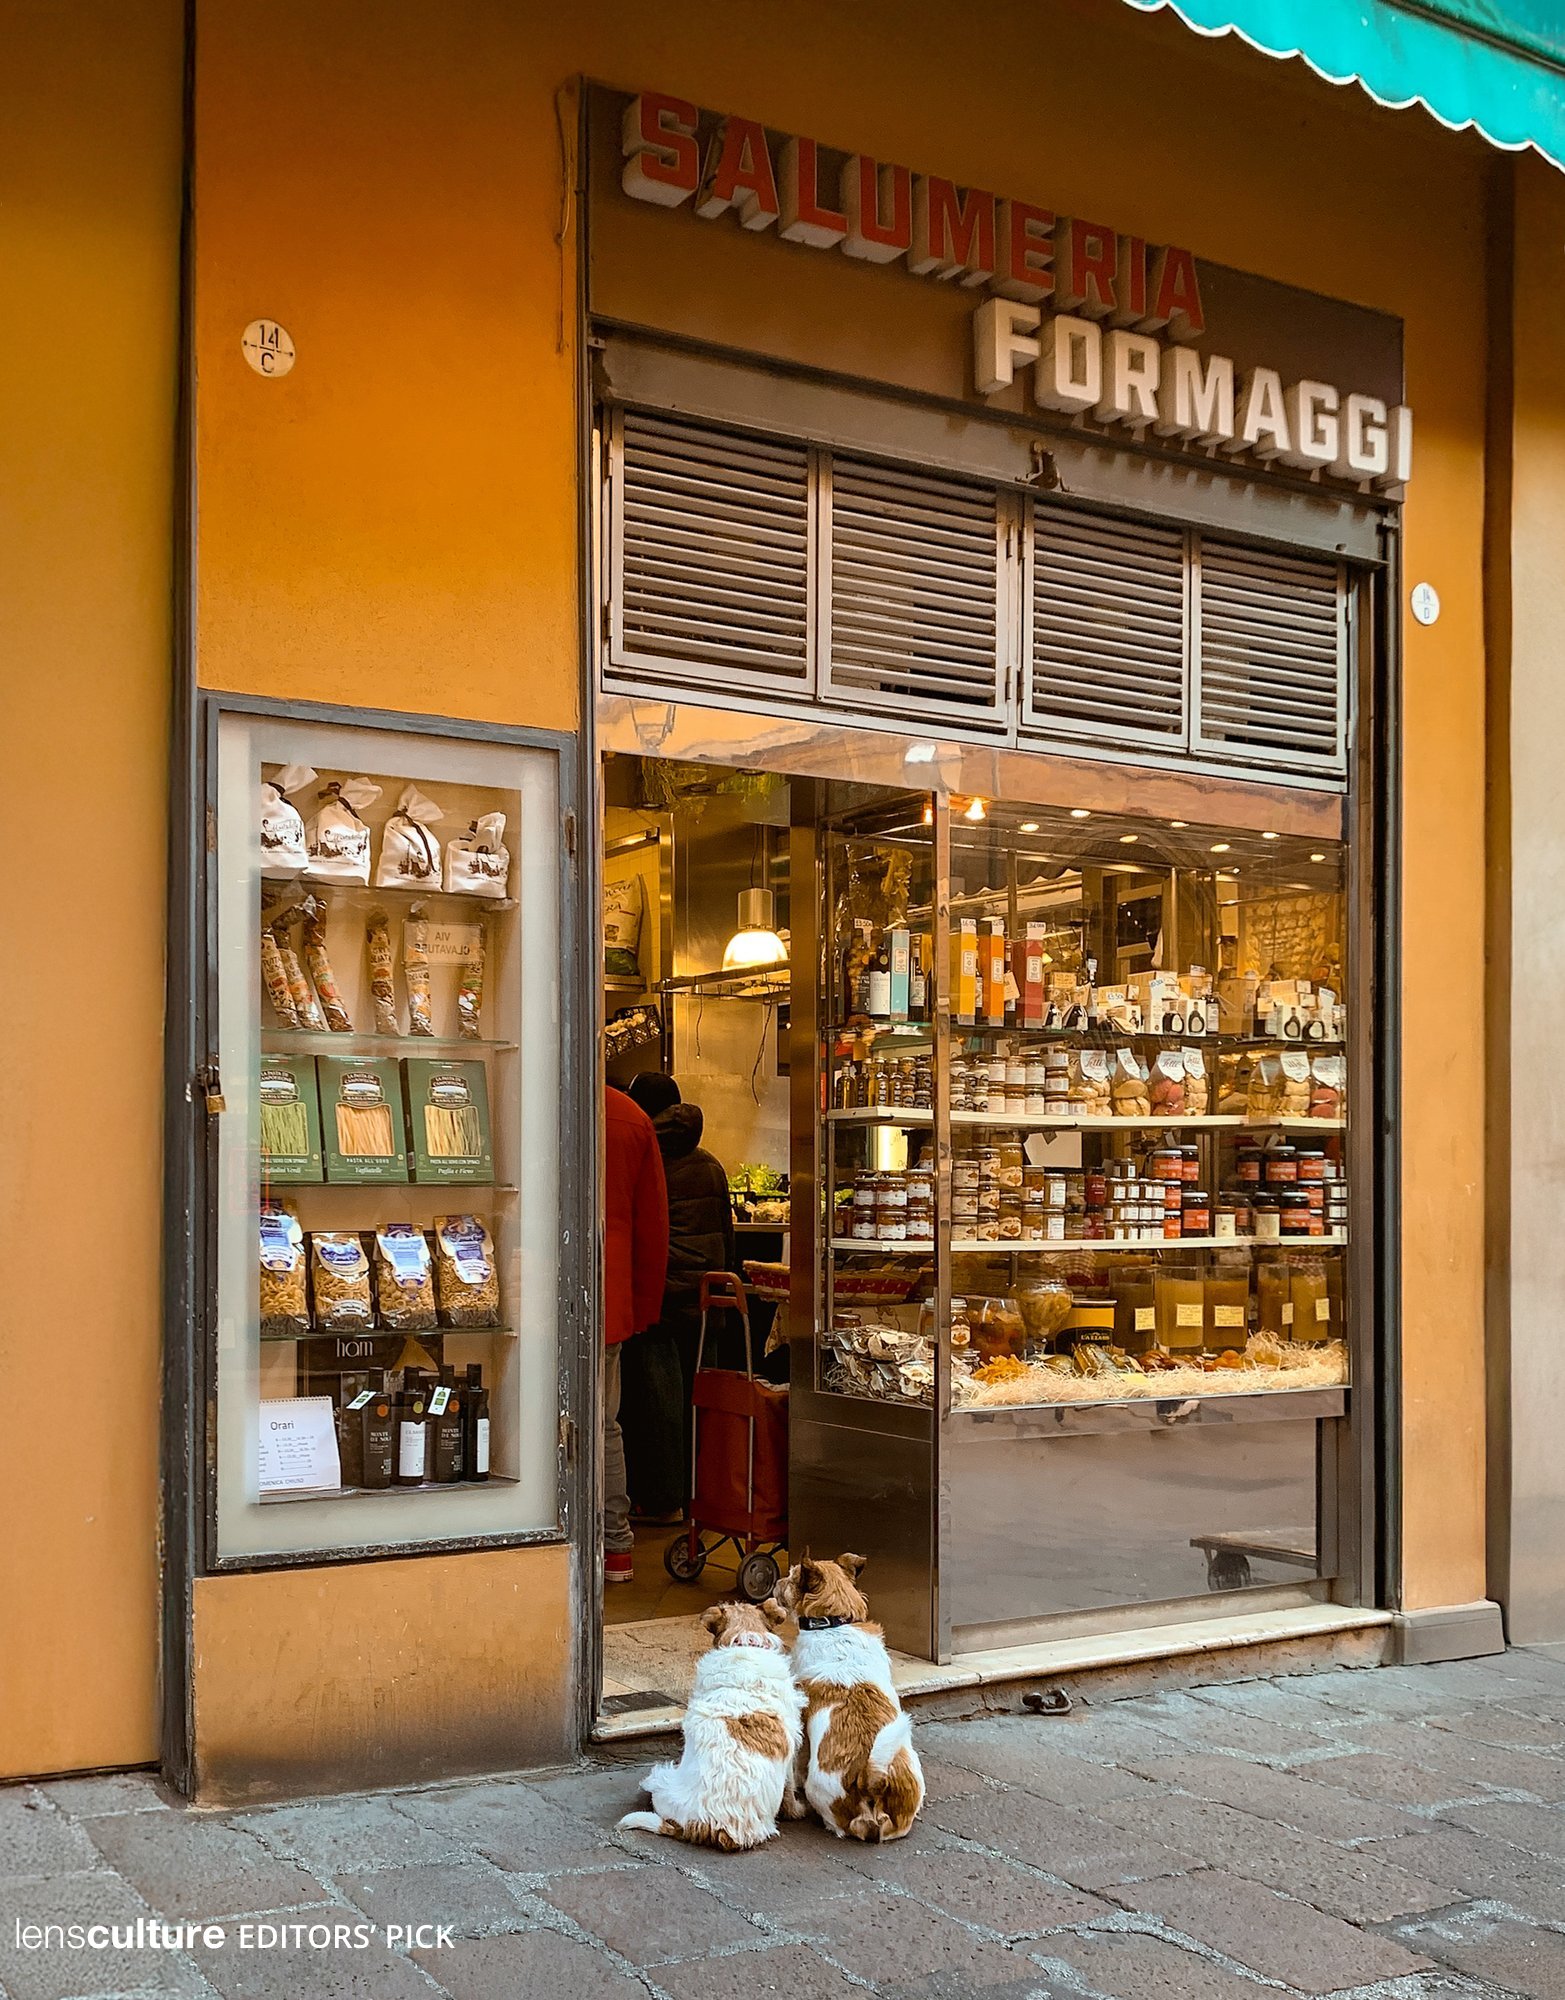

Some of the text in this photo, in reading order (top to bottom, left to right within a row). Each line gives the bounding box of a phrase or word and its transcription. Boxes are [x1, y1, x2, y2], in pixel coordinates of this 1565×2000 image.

[628, 91, 1205, 336] SALUMERIA
[259, 324, 279, 348] 14
[261, 352, 275, 373] C
[981, 296, 1412, 486] FORMAGGI
[270, 1420, 295, 1431] Orari
